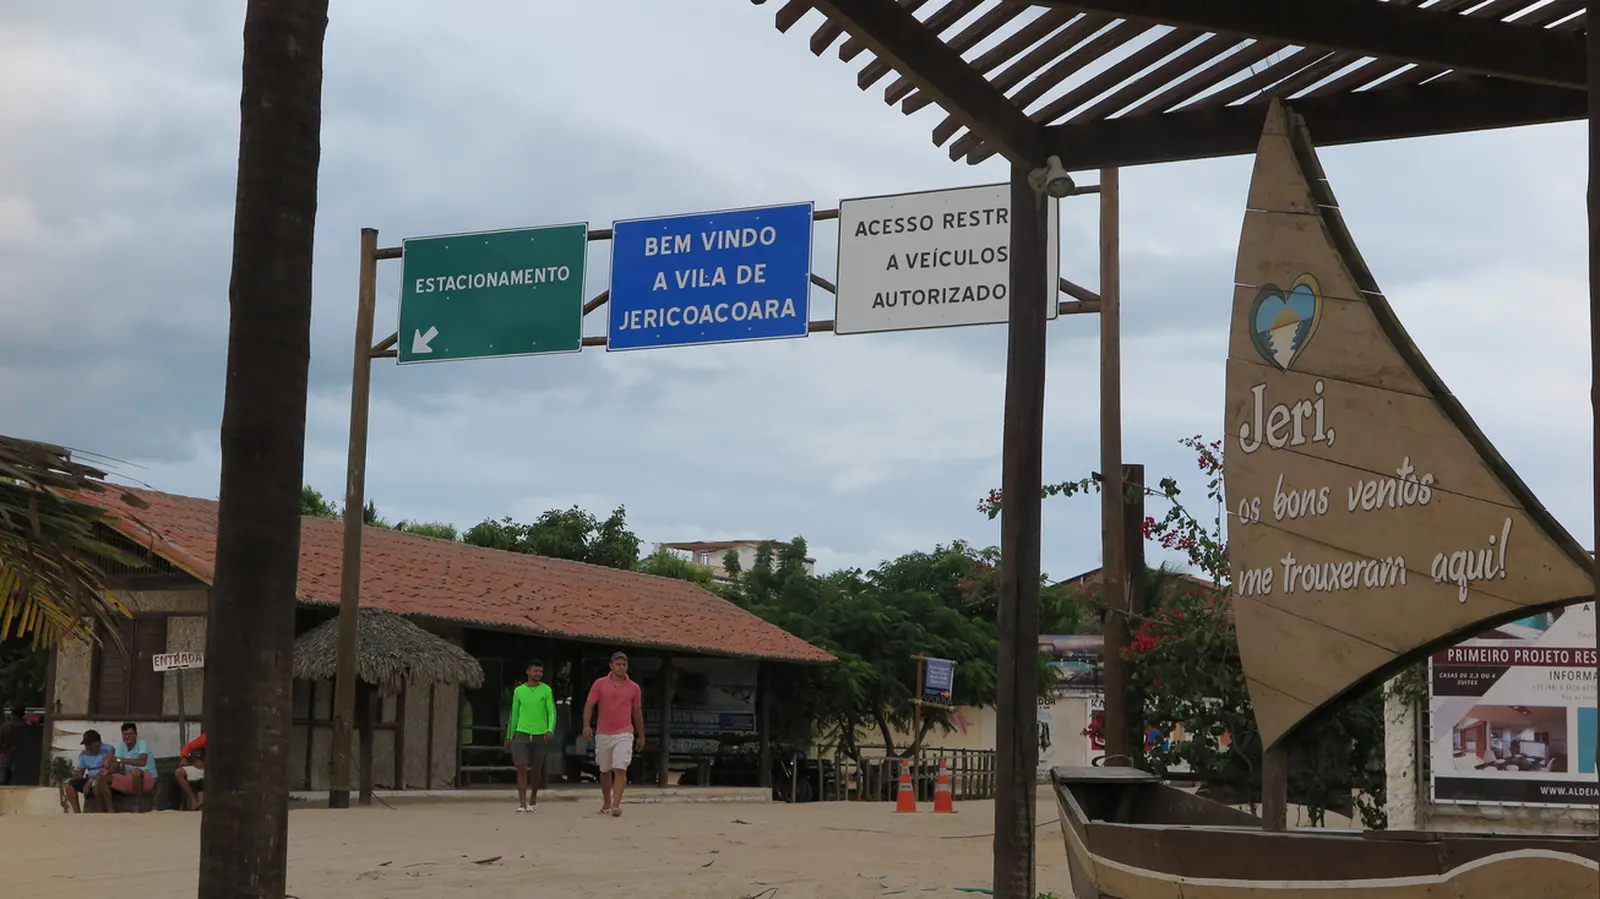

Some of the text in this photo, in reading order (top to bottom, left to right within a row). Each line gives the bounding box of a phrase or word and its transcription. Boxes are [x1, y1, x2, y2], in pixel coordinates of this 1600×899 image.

[854, 207, 1009, 237] ACESSO RESTR
[645, 226, 777, 257] BEM VINDO
[886, 246, 1009, 271] A VEÍCULOS
[415, 265, 570, 294] ESTACIONAMENTO
[652, 264, 767, 291] A VILA DE
[872, 284, 1007, 309] AUTORIZADO
[619, 298, 796, 331] JERICOACOARA
[1238, 379, 1336, 453] Jeri,
[1238, 456, 1435, 525] os bons ventos
[1238, 516, 1513, 603] me trouxeram aqui!
[154, 652, 203, 667] ENTRADA
[1448, 648, 1597, 664] PRIMEIRO PROJETO RES
[1549, 670, 1597, 681] INFORMA
[1540, 786, 1600, 797] WWW.ALDEIA
